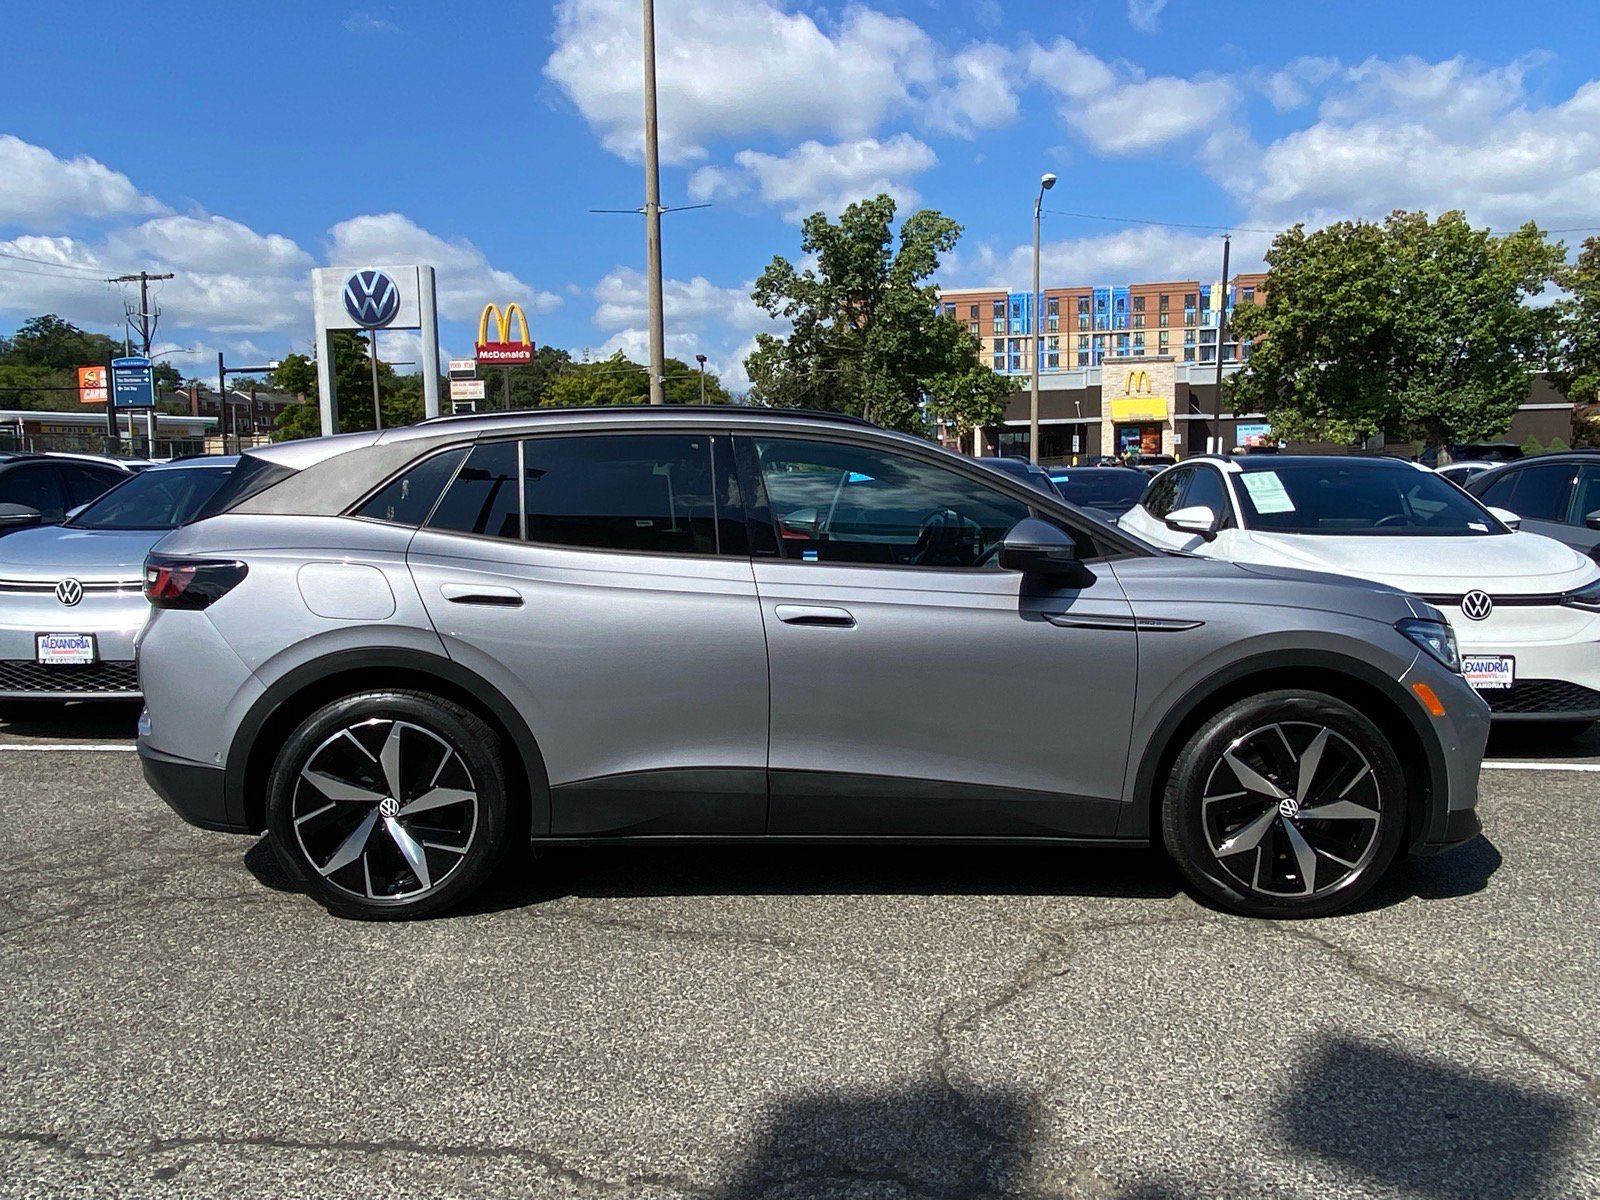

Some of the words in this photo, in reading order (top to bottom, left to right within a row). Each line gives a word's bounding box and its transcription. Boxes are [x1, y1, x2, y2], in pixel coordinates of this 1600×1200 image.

[479, 351, 530, 359] McDonald's
[41, 638, 90, 649] ALEXANDRIA
[1464, 661, 1509, 673] EXANDRIA
